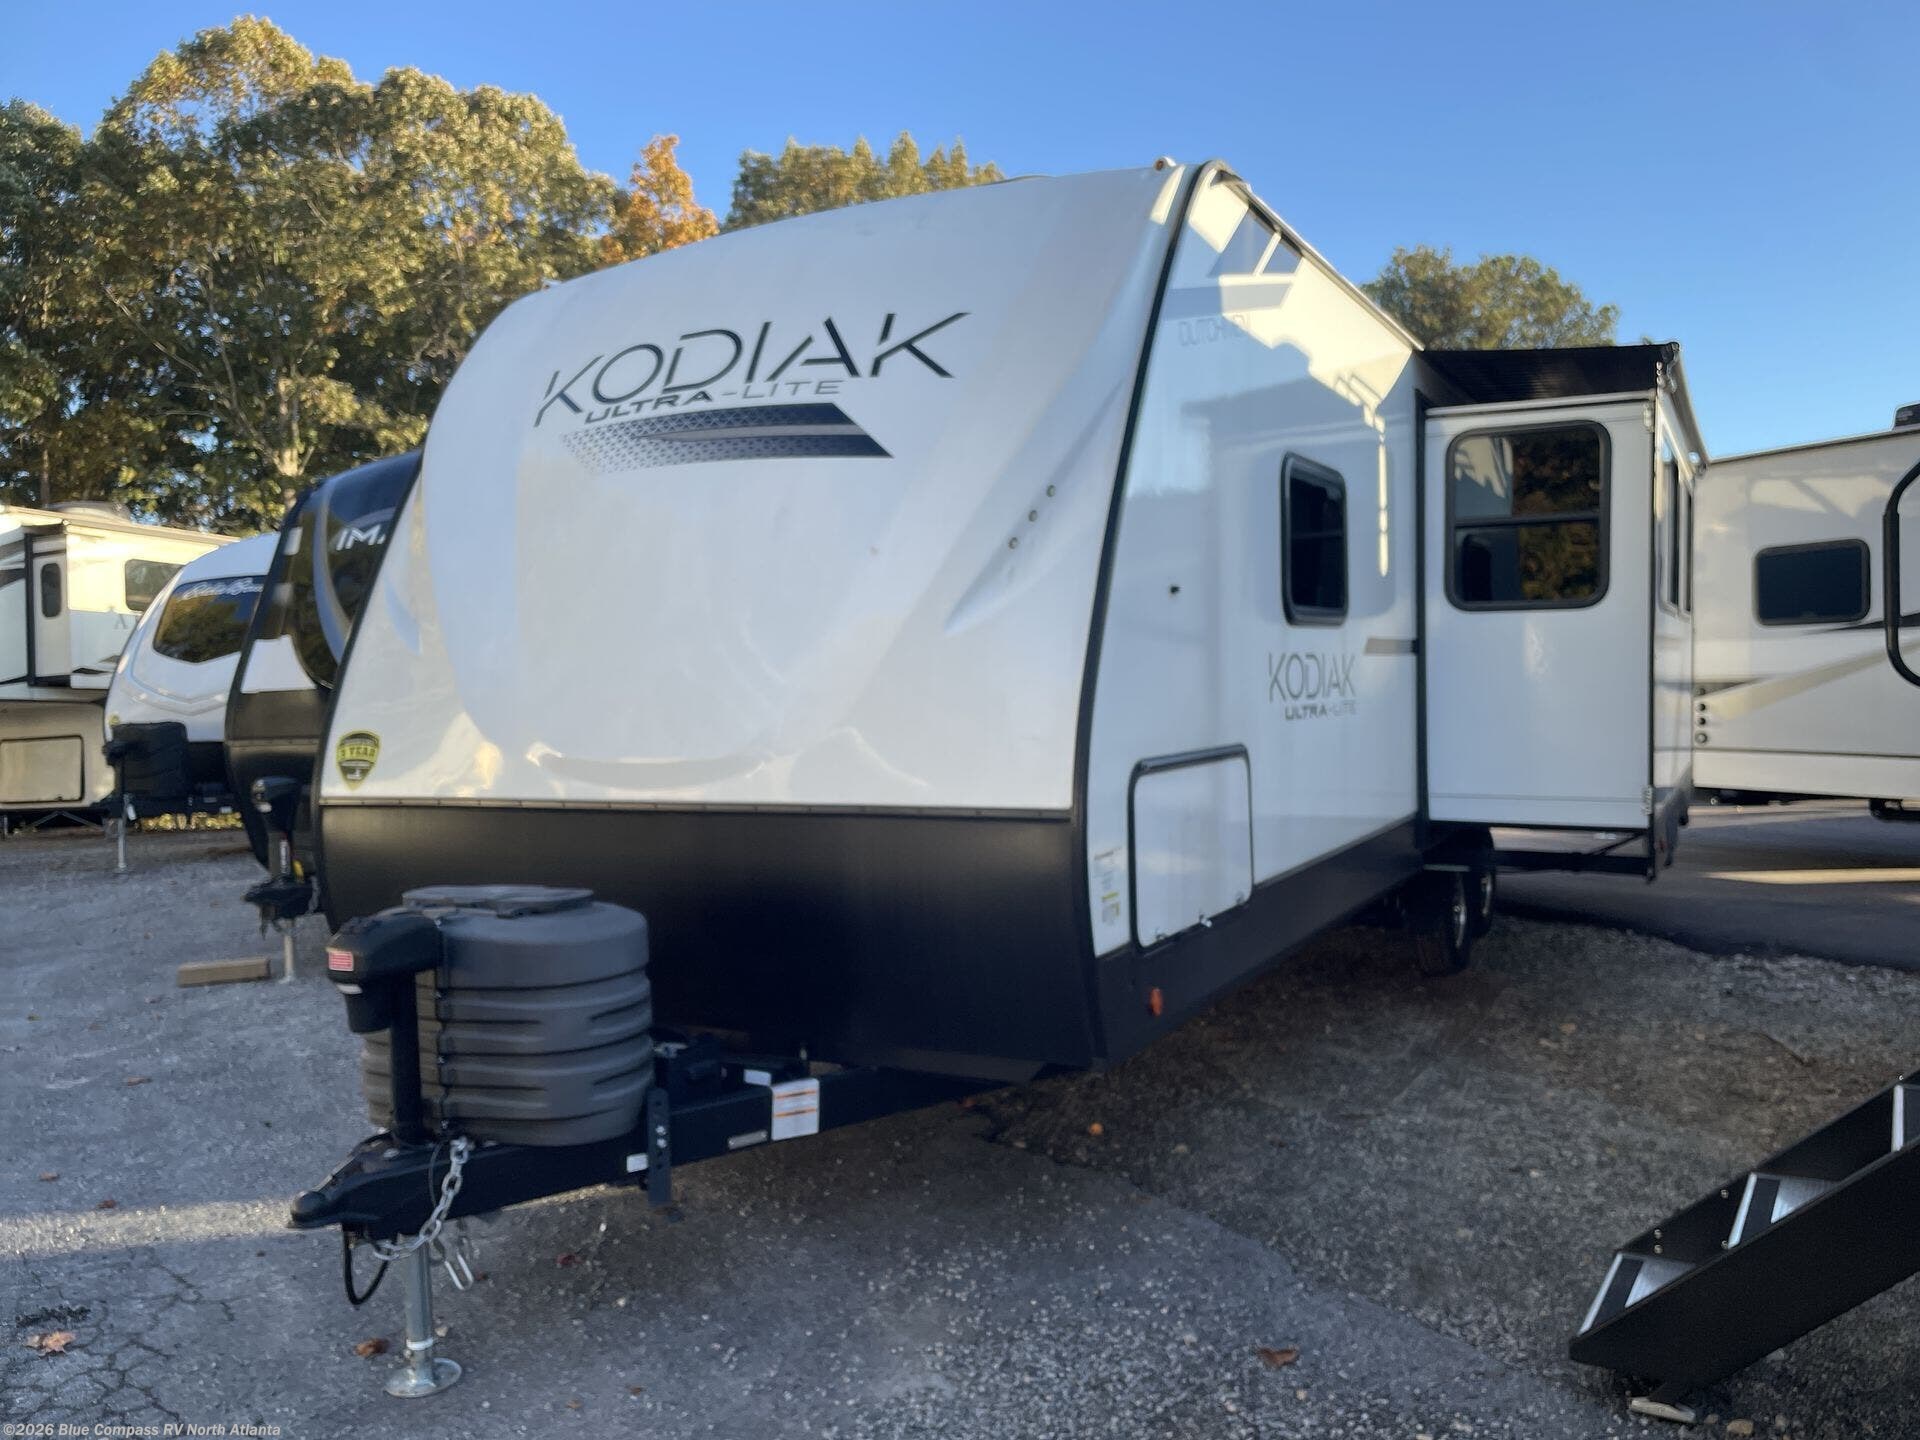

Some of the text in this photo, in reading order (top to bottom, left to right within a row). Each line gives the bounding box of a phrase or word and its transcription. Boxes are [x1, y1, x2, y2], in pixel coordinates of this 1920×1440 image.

[534, 311, 972, 428] KODIAK
[584, 379, 844, 425] ULTRA-LITE
[1268, 652, 1356, 702] KODIAK
